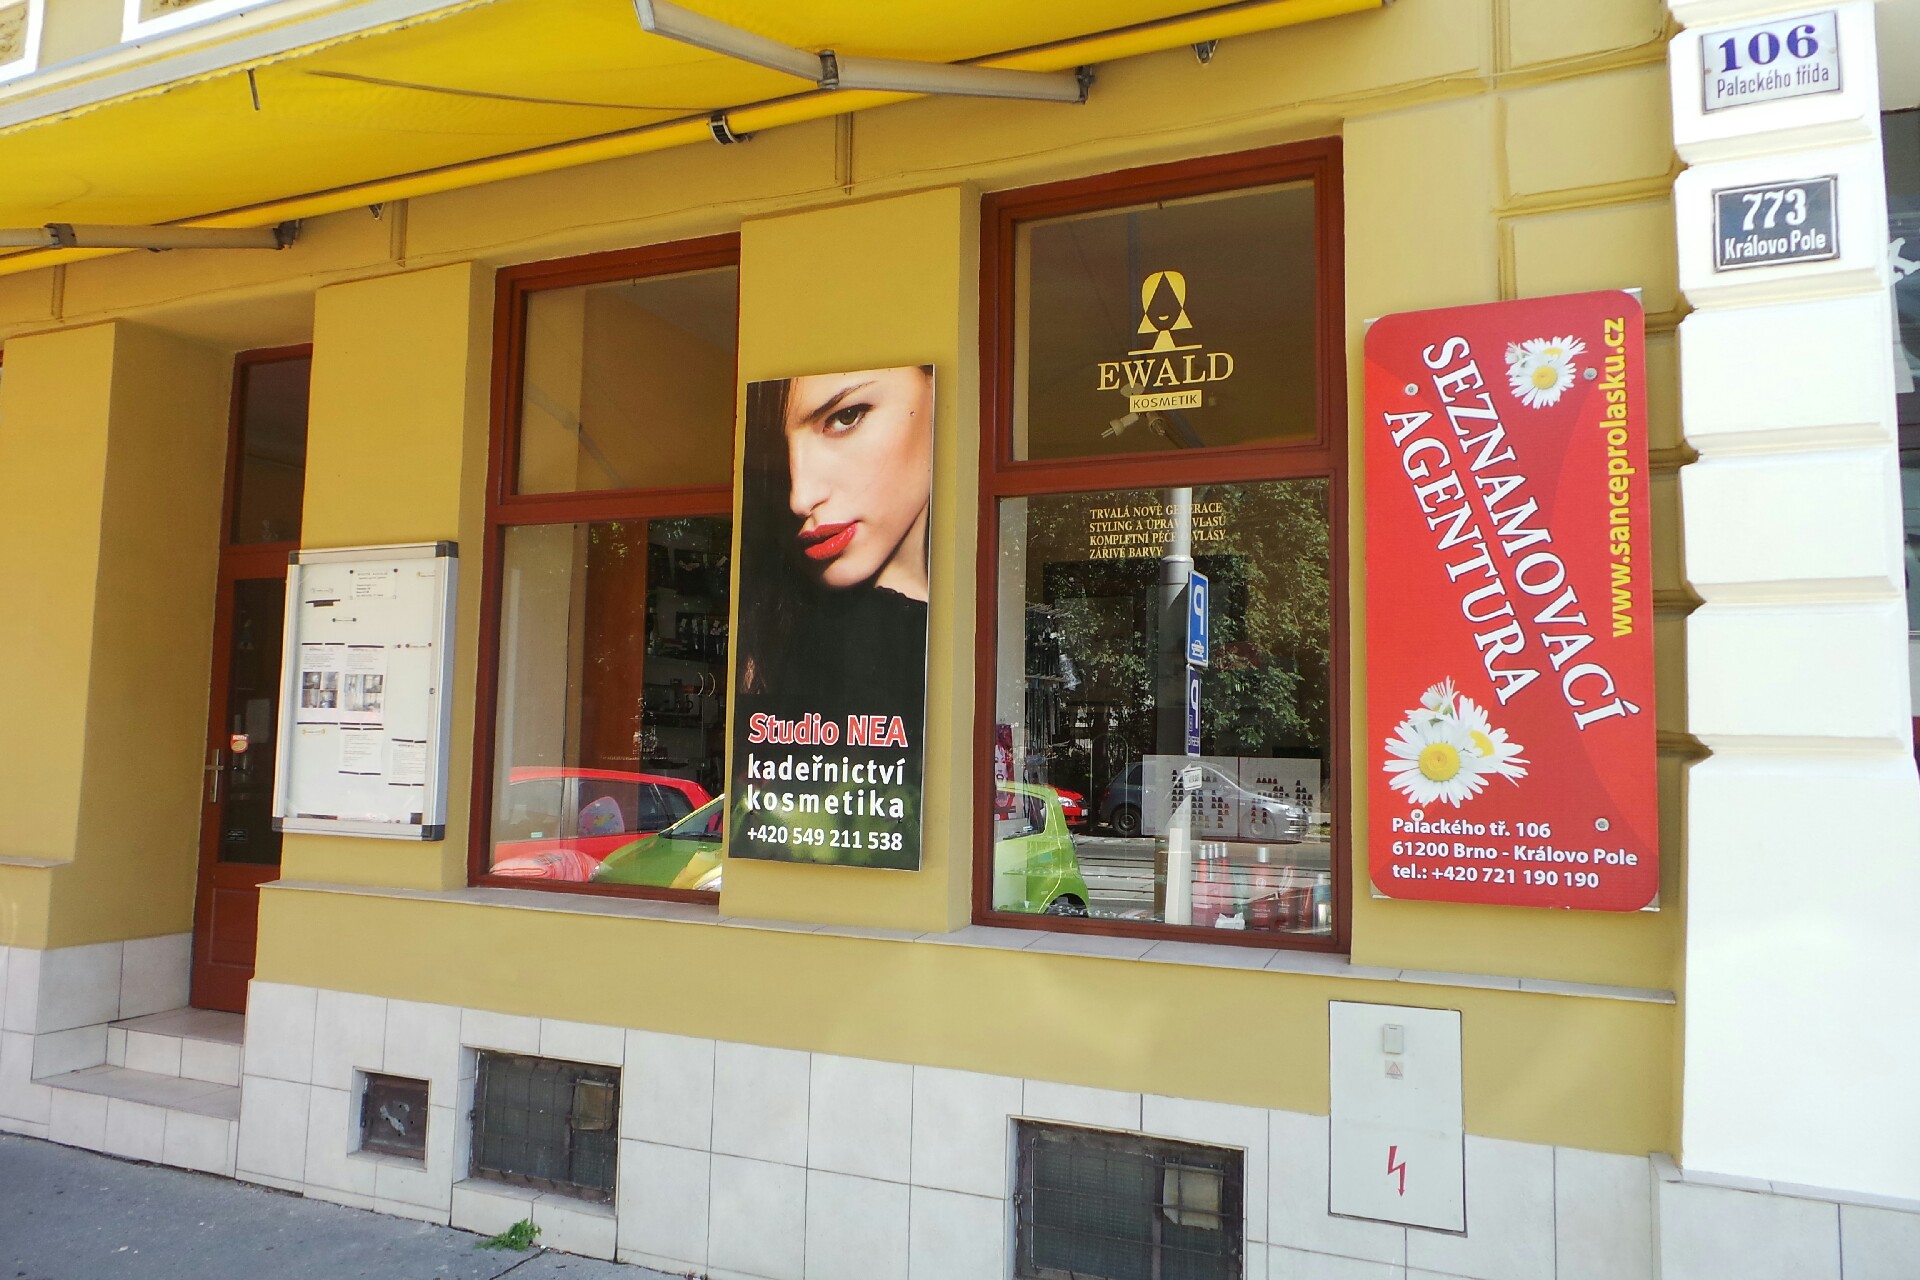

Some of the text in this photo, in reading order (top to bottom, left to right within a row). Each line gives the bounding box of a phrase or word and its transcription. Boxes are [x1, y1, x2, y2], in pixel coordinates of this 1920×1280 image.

[1719, 24, 1819, 73] 106
[1717, 62, 1829, 98] Palackého třída
[1742, 188, 1807, 231] 773
[1725, 228, 1826, 259] Královo Pole
[1097, 352, 1234, 391] EWALD
[1133, 394, 1198, 409] KOSMETIK
[1598, 317, 1635, 638] www.sanceprolasku.cz
[1090, 502, 1223, 519] TRVALÁ NOVÉ GEERACE
[1090, 512, 1226, 533] STYLING A ÚPRAV VLASŮ
[1090, 531, 1149, 546] KOMPLETNÍ
[1152, 530, 1177, 543] PÉČE
[1192, 529, 1226, 541] VLASY
[1422, 336, 1641, 731] SEZNAMOVACÍ
[1090, 546, 1163, 559] ZÁŘIVÉ BARVY
[1383, 410, 1541, 705] AGENTURA
[748, 712, 908, 748] Studio NEA
[747, 753, 906, 785] kadeřnictví
[746, 784, 905, 819] kosmetika
[747, 825, 903, 851] +420 549 211 538
[1392, 817, 1551, 838] Palackého tř. 106
[1392, 841, 1449, 857] 61200
[1453, 843, 1498, 860] Brno
[1514, 845, 1589, 864] Královo
[1593, 848, 1638, 866] Pole
[1392, 863, 1600, 888] tel.: +420 721 190 190
